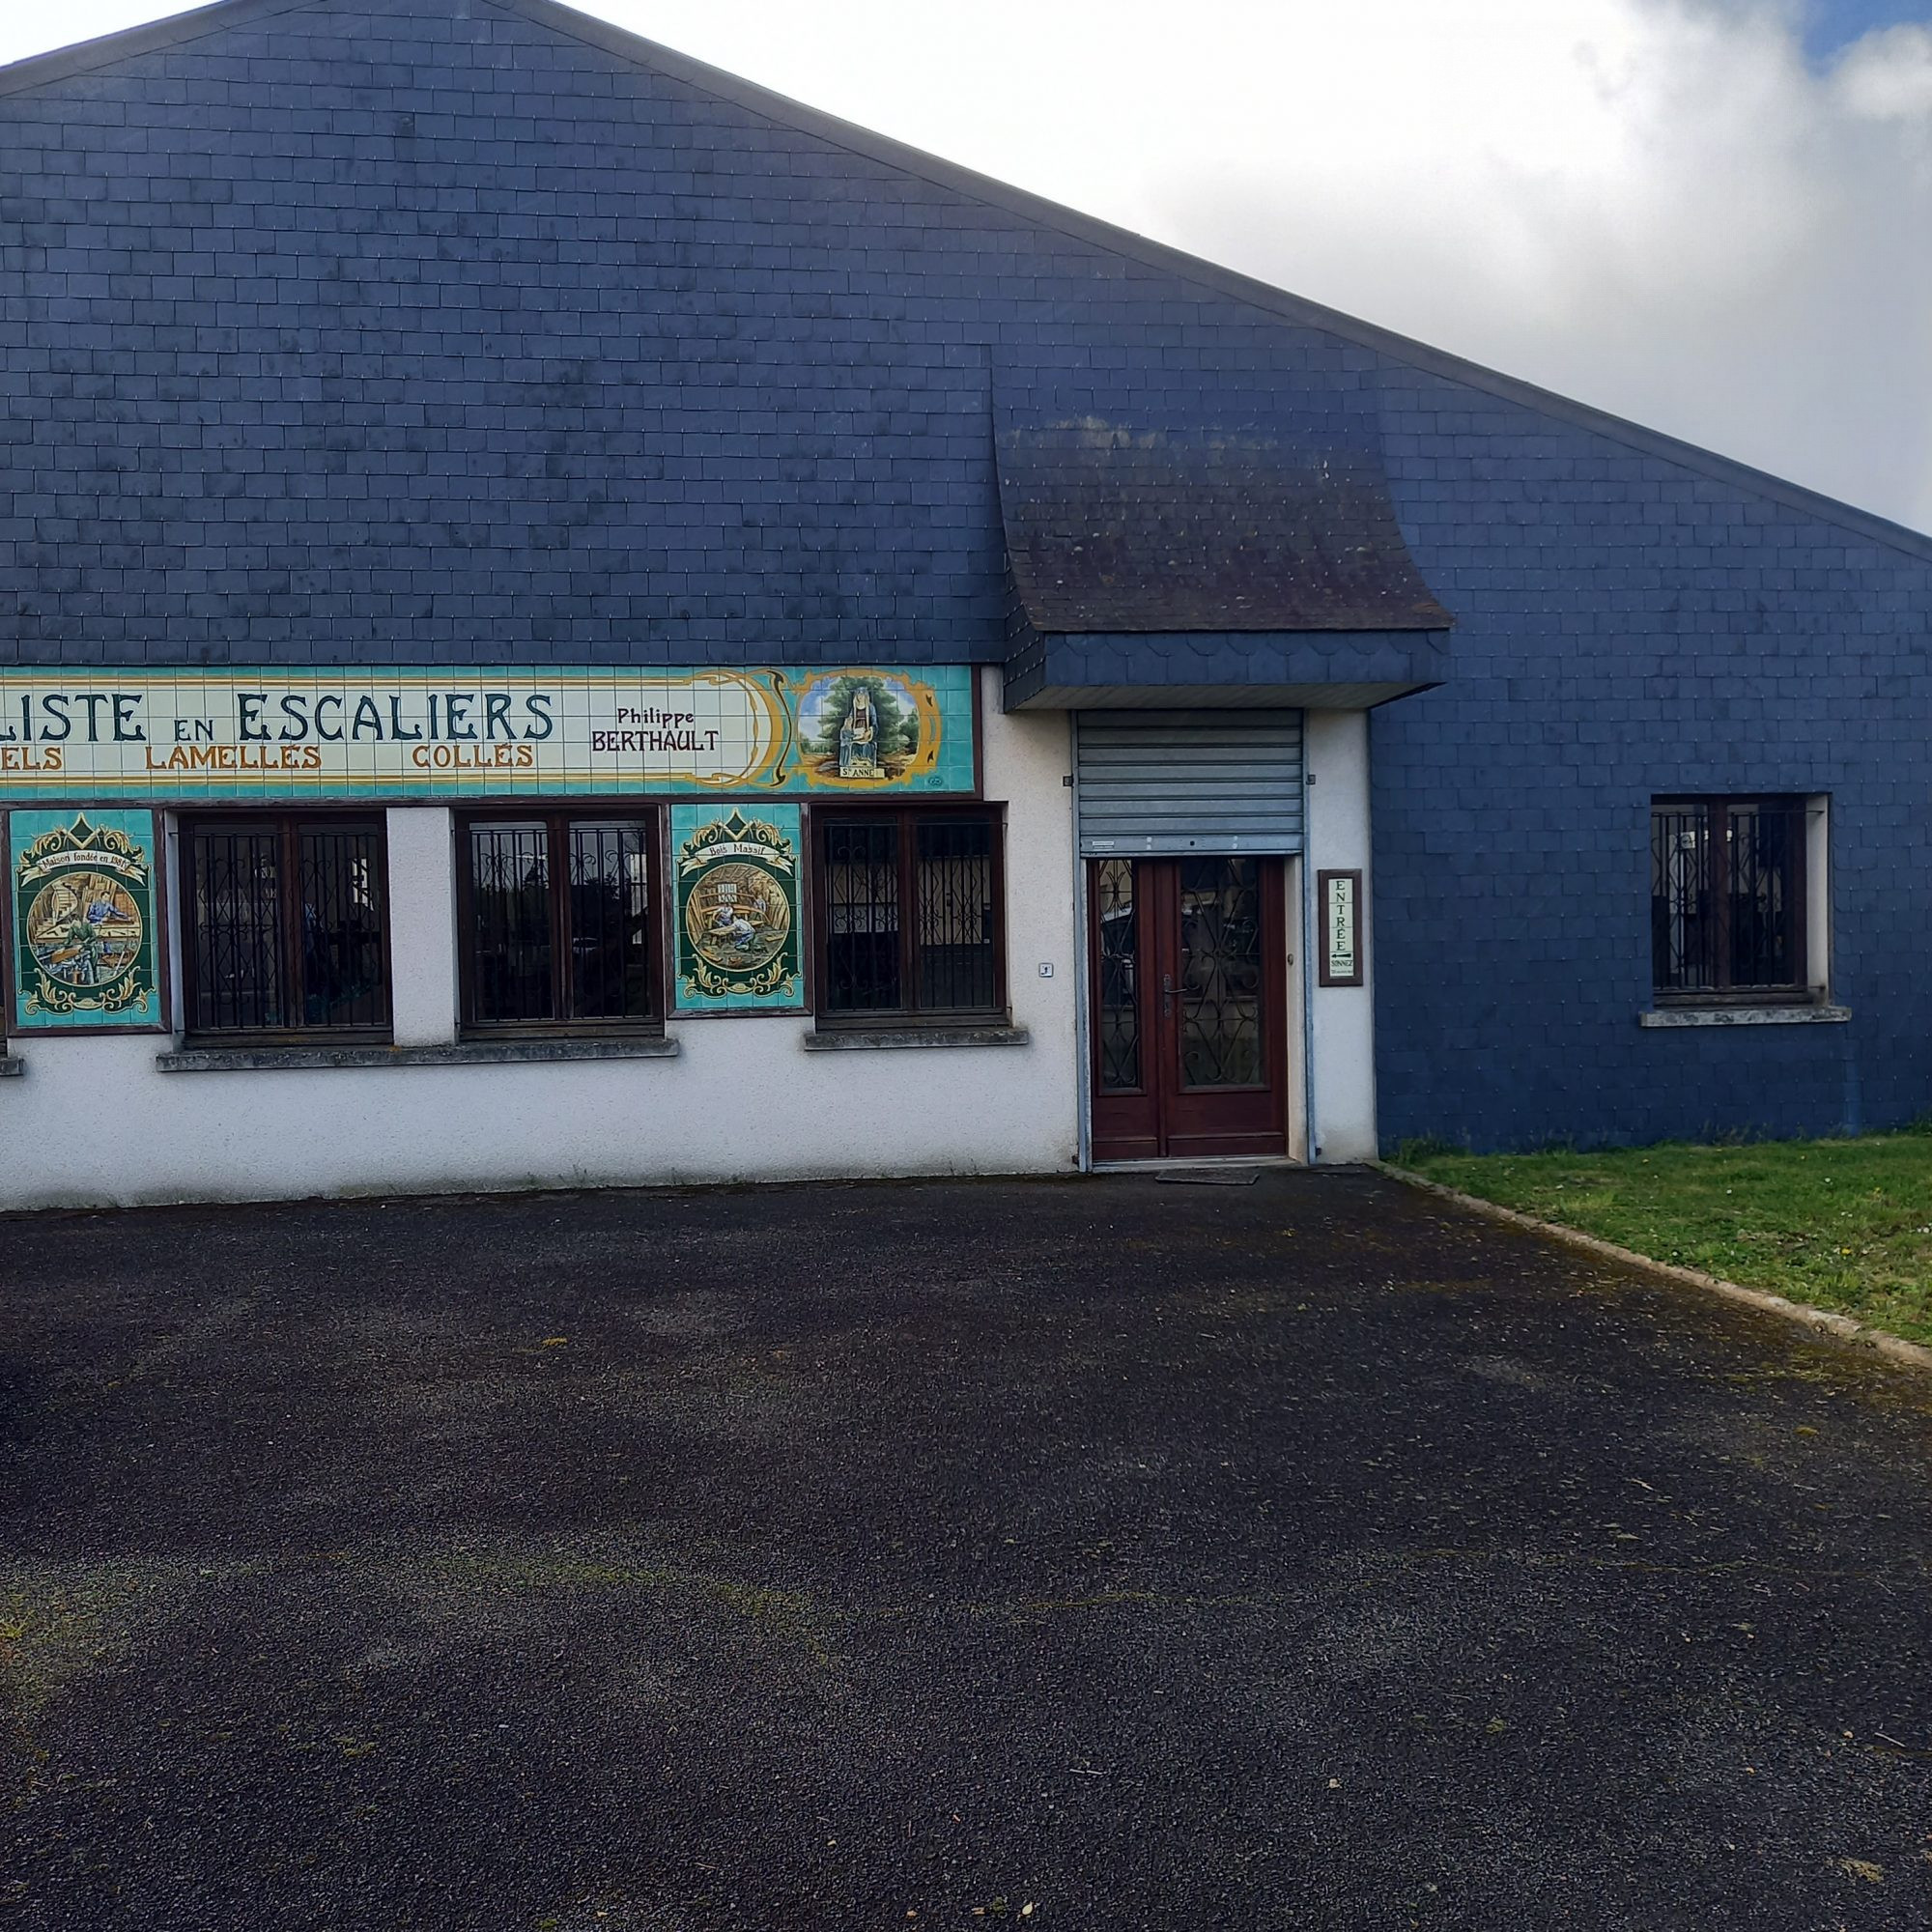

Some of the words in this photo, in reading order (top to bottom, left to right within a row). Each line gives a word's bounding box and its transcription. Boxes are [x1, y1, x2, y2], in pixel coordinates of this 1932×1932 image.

[174, 719, 213, 742] EN
[237, 693, 554, 741] ESCALIERS
[617, 707, 695, 728] Philippe
[592, 730, 719, 752] BERTHAULT
[412, 743, 534, 768] COLLÉS
[43, 854, 70, 868] Maison
[73, 852, 98, 862] fondée
[710, 844, 727, 856] Bois
[733, 843, 766, 855] Massif
